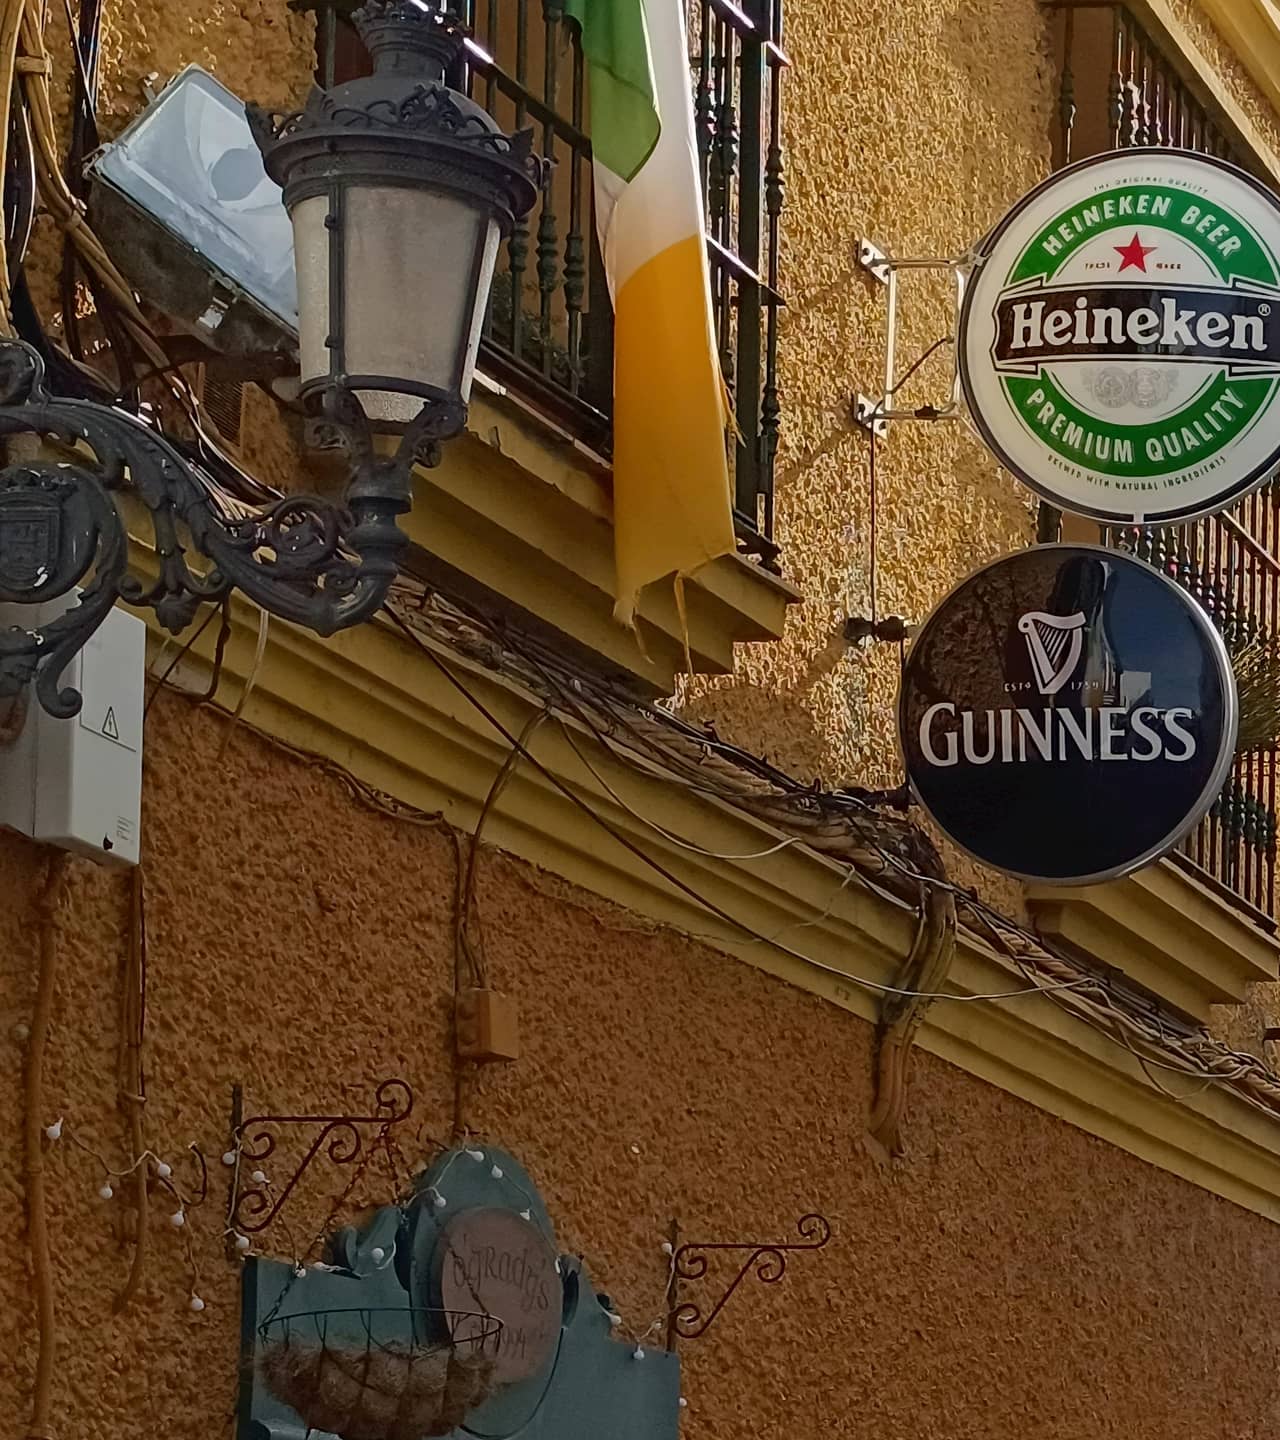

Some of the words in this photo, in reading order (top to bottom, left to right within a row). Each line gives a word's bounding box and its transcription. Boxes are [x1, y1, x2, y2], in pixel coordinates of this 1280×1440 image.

[1041, 194, 1173, 257] HEINEKEN
[1180, 202, 1244, 258] BEER
[1009, 296, 1269, 351] Heineken
[1025, 386, 1135, 465] PREMIUM
[1145, 384, 1248, 463] QUALITY
[1115, 481, 1158, 492] NATURAL
[1163, 455, 1227, 489] INGREDIENTS
[919, 702, 1197, 767] GUINNESS
